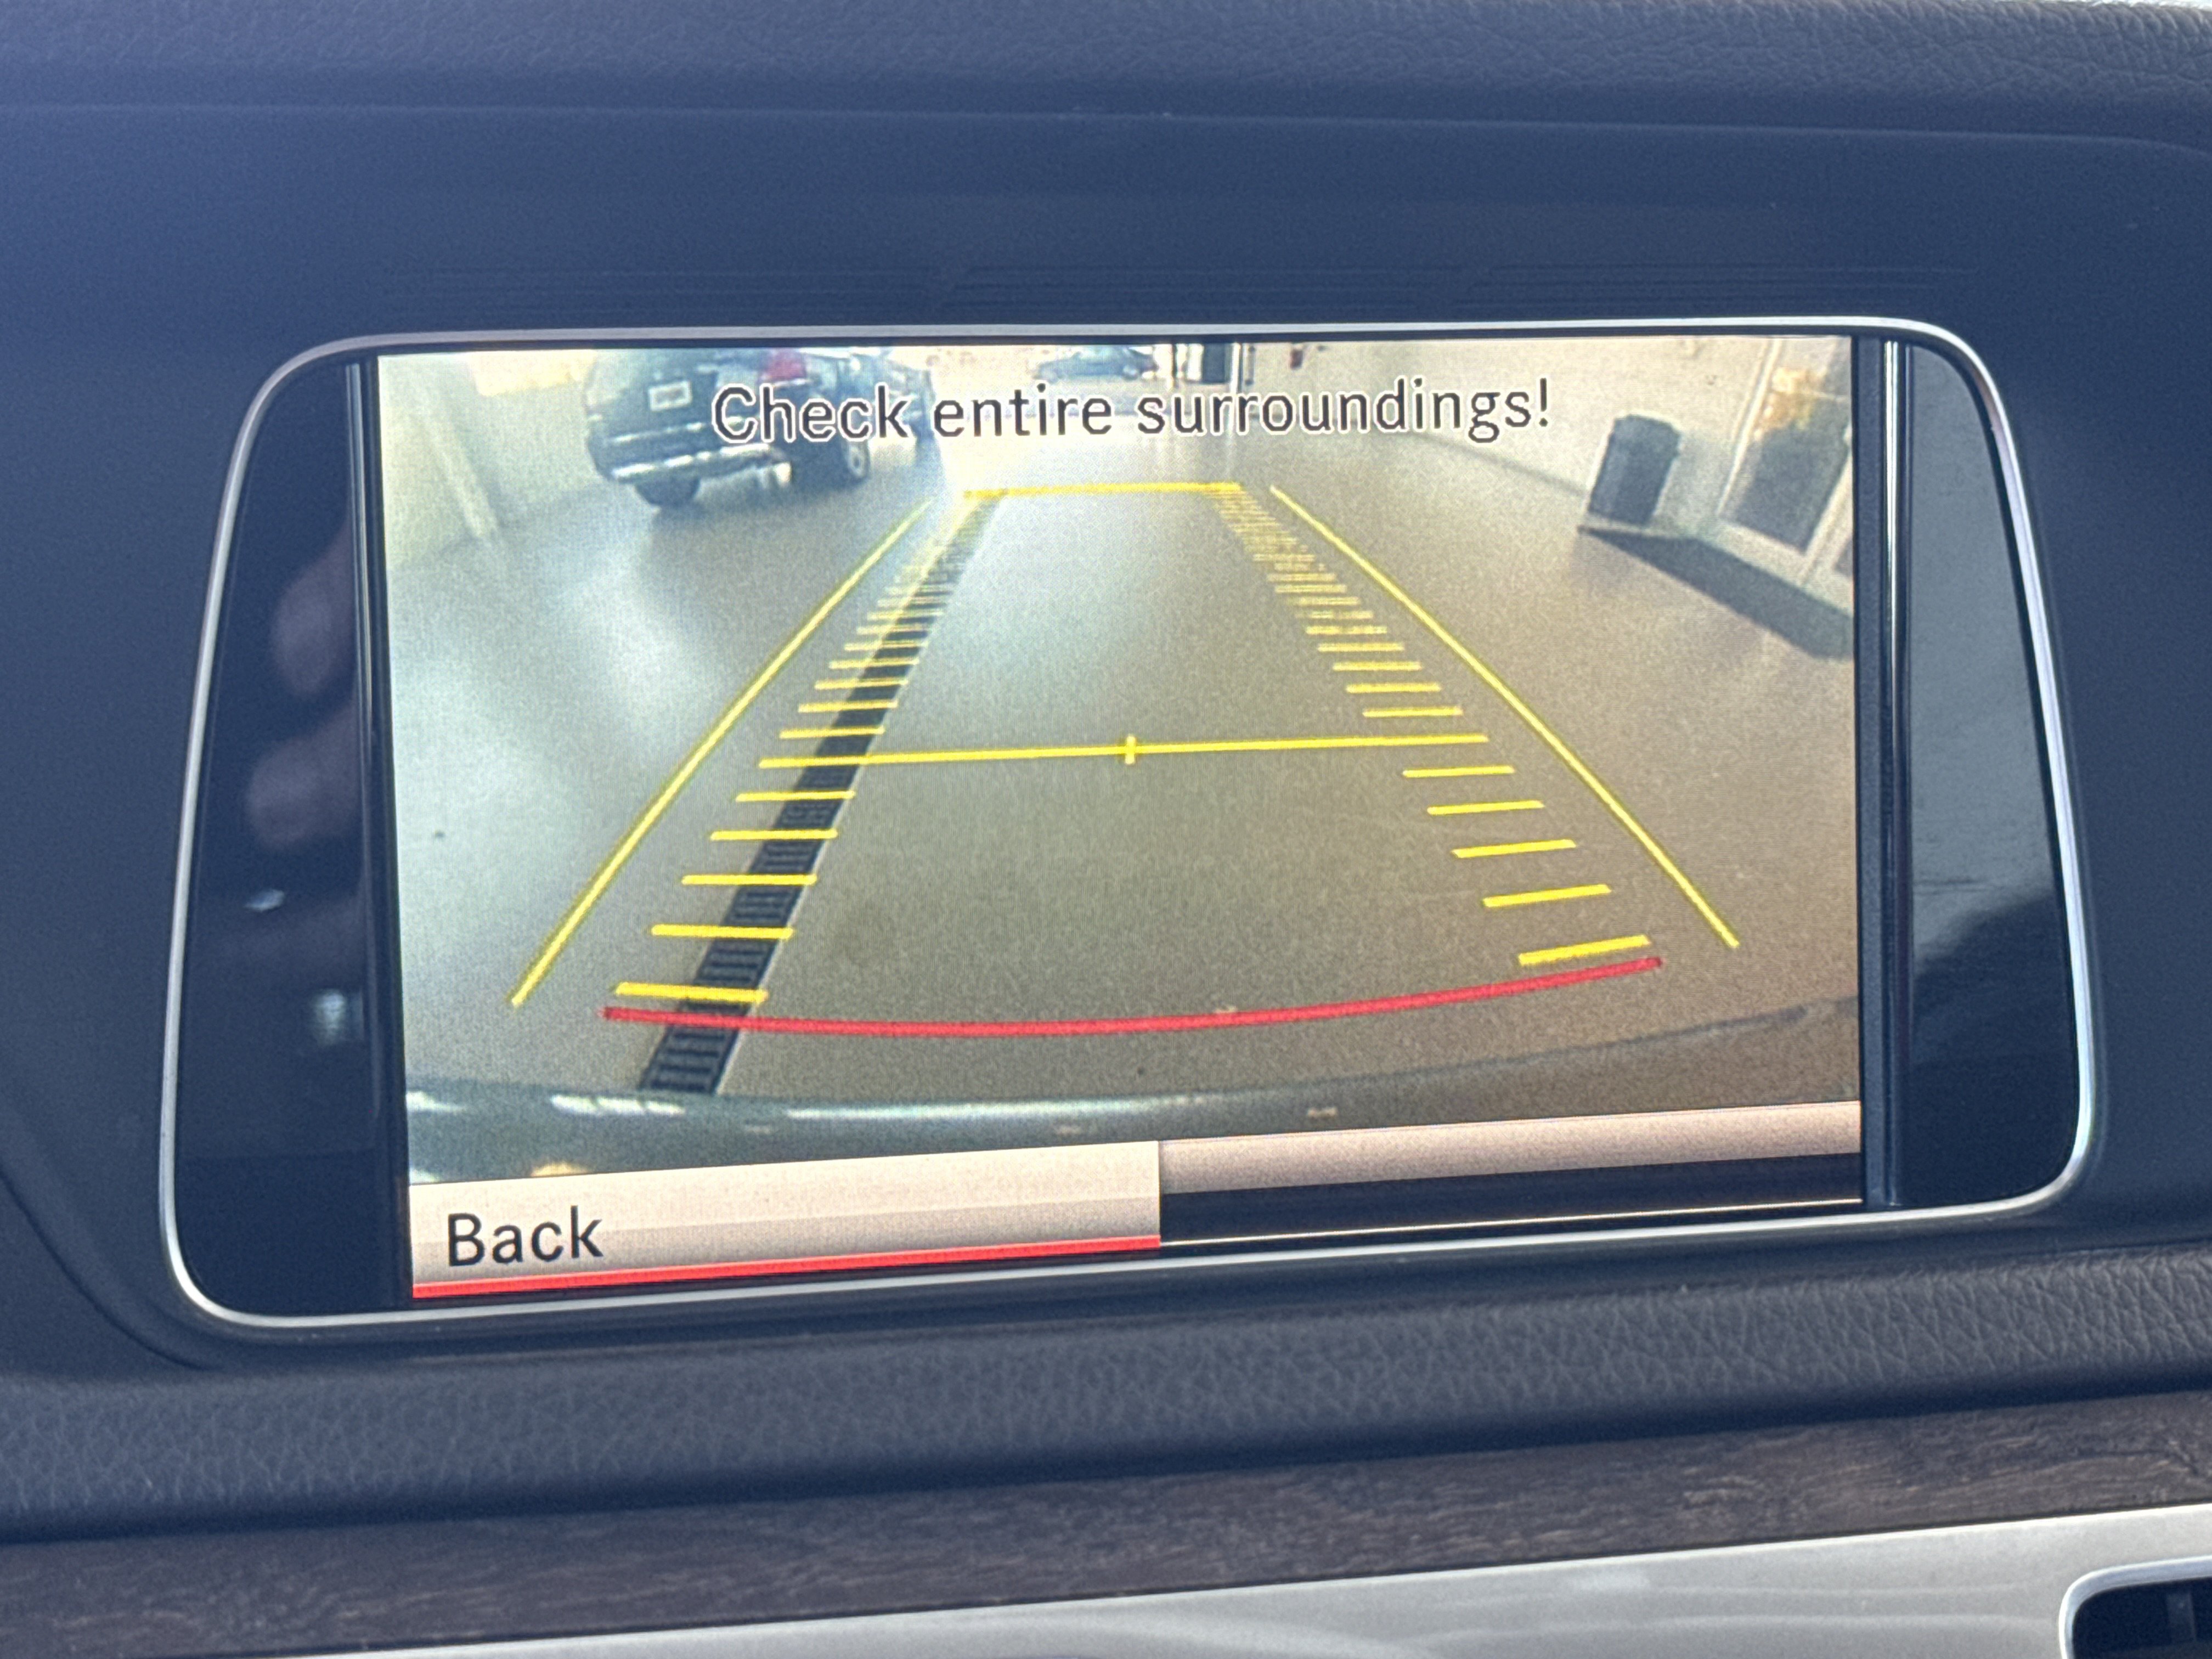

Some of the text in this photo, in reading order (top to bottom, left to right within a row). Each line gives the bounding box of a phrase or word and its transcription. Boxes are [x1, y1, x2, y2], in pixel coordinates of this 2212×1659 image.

[713, 377, 1549, 443] Check entire surroundings!
[448, 1205, 604, 1267] Back
